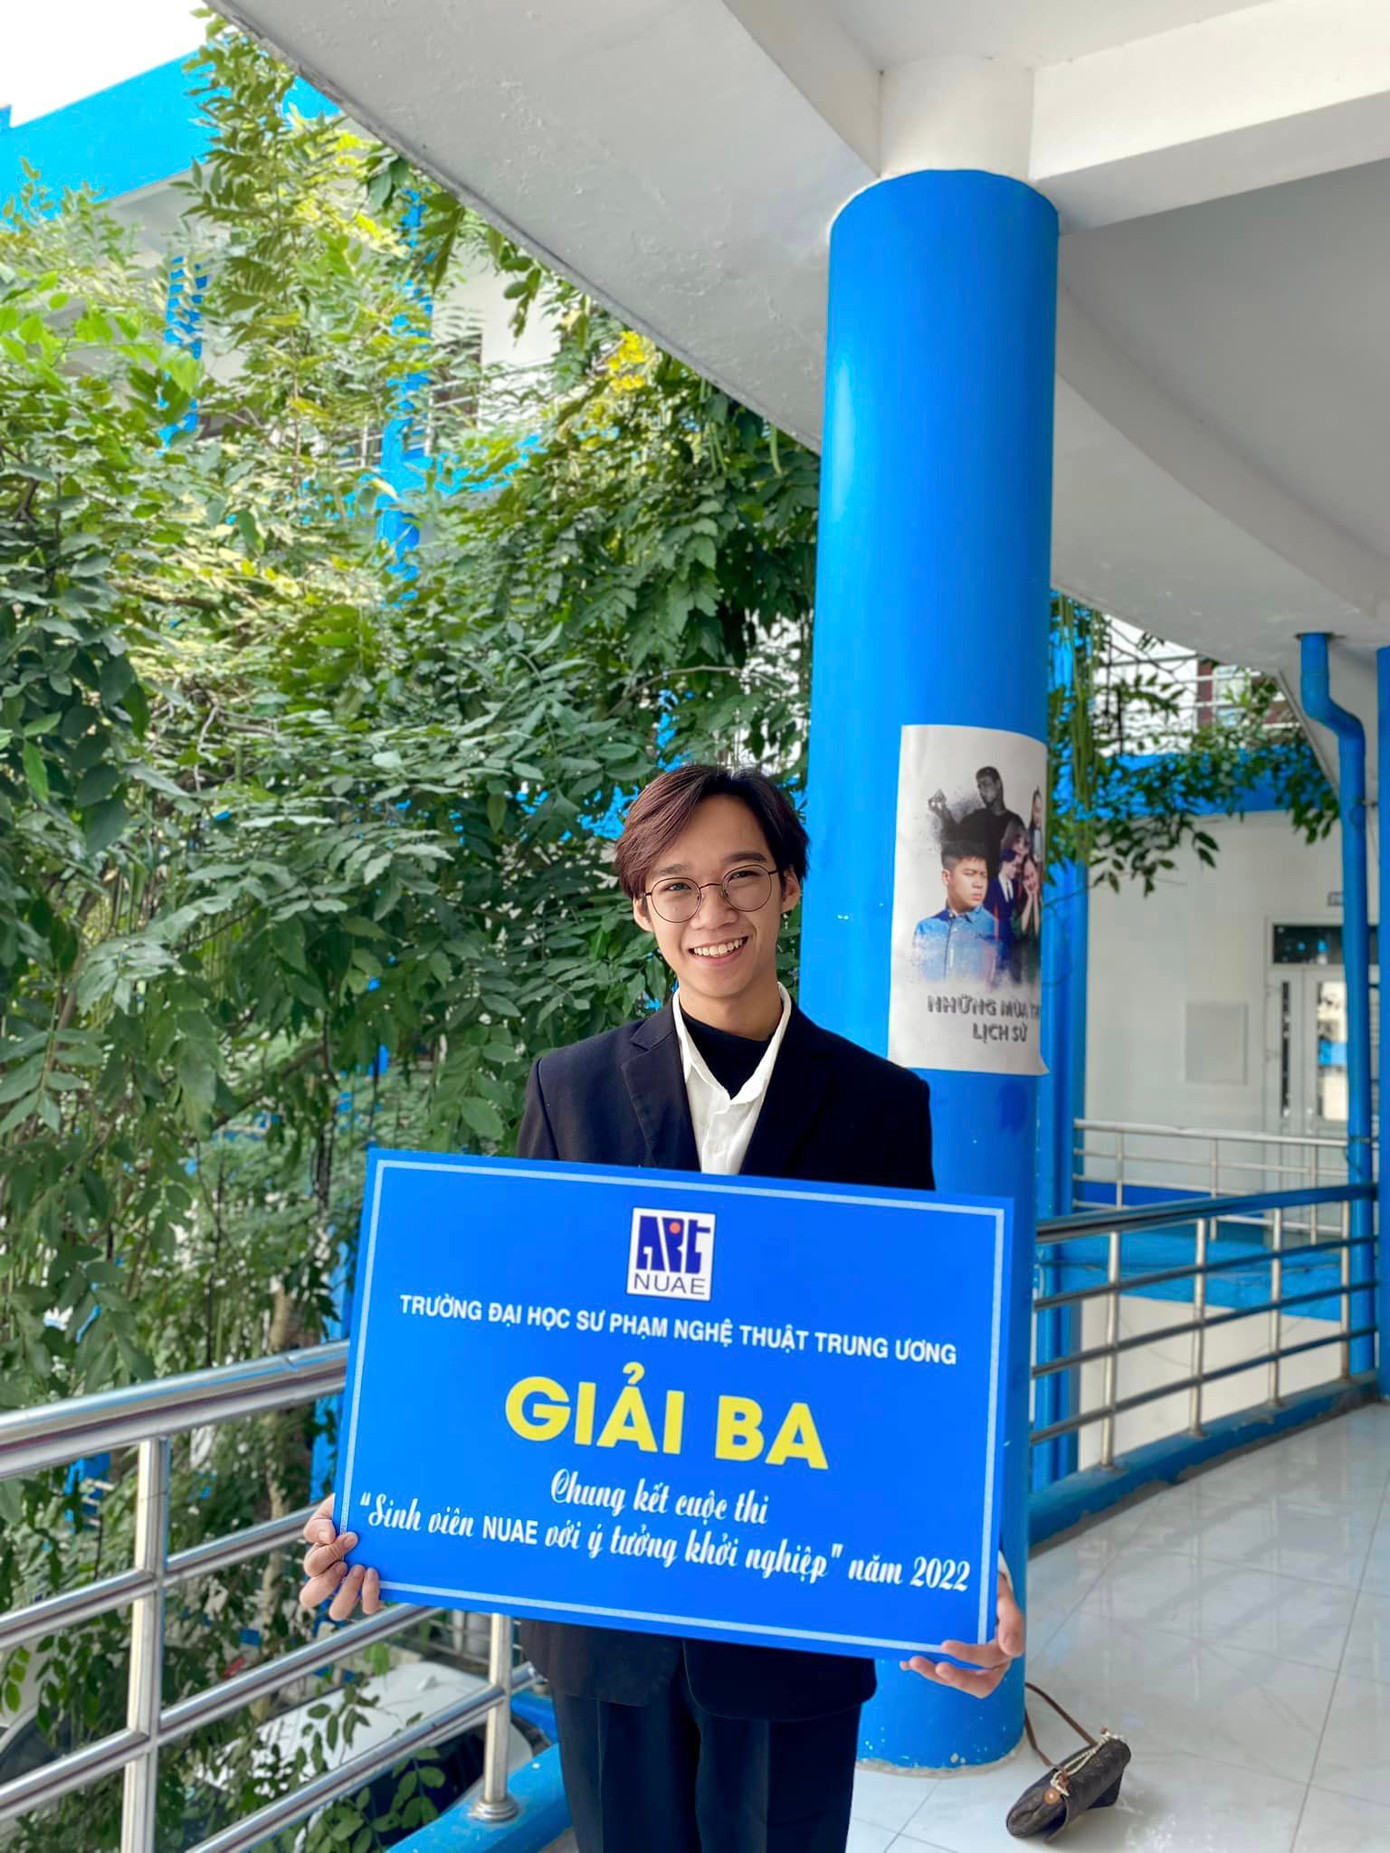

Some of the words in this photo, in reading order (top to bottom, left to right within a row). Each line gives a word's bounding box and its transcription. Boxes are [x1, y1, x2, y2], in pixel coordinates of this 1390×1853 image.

[973, 1022, 1009, 1044] LỊCH
[634, 1273, 706, 1296] NUAE
[400, 1294, 482, 1321] TRƯỜNG
[488, 1302, 522, 1328] ĐẠI
[527, 1306, 571, 1331] HỌC
[576, 1309, 606, 1332] SƯ
[609, 1313, 668, 1340] PHẠM
[673, 1318, 733, 1347] NGHỆ
[739, 1324, 809, 1354] THUẬT
[814, 1332, 889, 1358] TRUNG
[895, 1338, 957, 1365] ƯƠNG
[505, 1361, 685, 1455] GIẢI
[715, 1395, 829, 1470] BA
[551, 1468, 627, 1518] Chung
[633, 1478, 670, 1514] kết
[675, 1490, 728, 1526] cuộc
[734, 1490, 769, 1525] thi
[428, 1506, 475, 1537] viên
[482, 1516, 539, 1545] NUAE
[545, 1519, 580, 1550] với
[587, 1524, 603, 1559] ý
[610, 1524, 678, 1568] tưởng
[685, 1529, 739, 1567] khởi
[848, 1554, 904, 1585] năm
[910, 1556, 971, 1592] 2022
